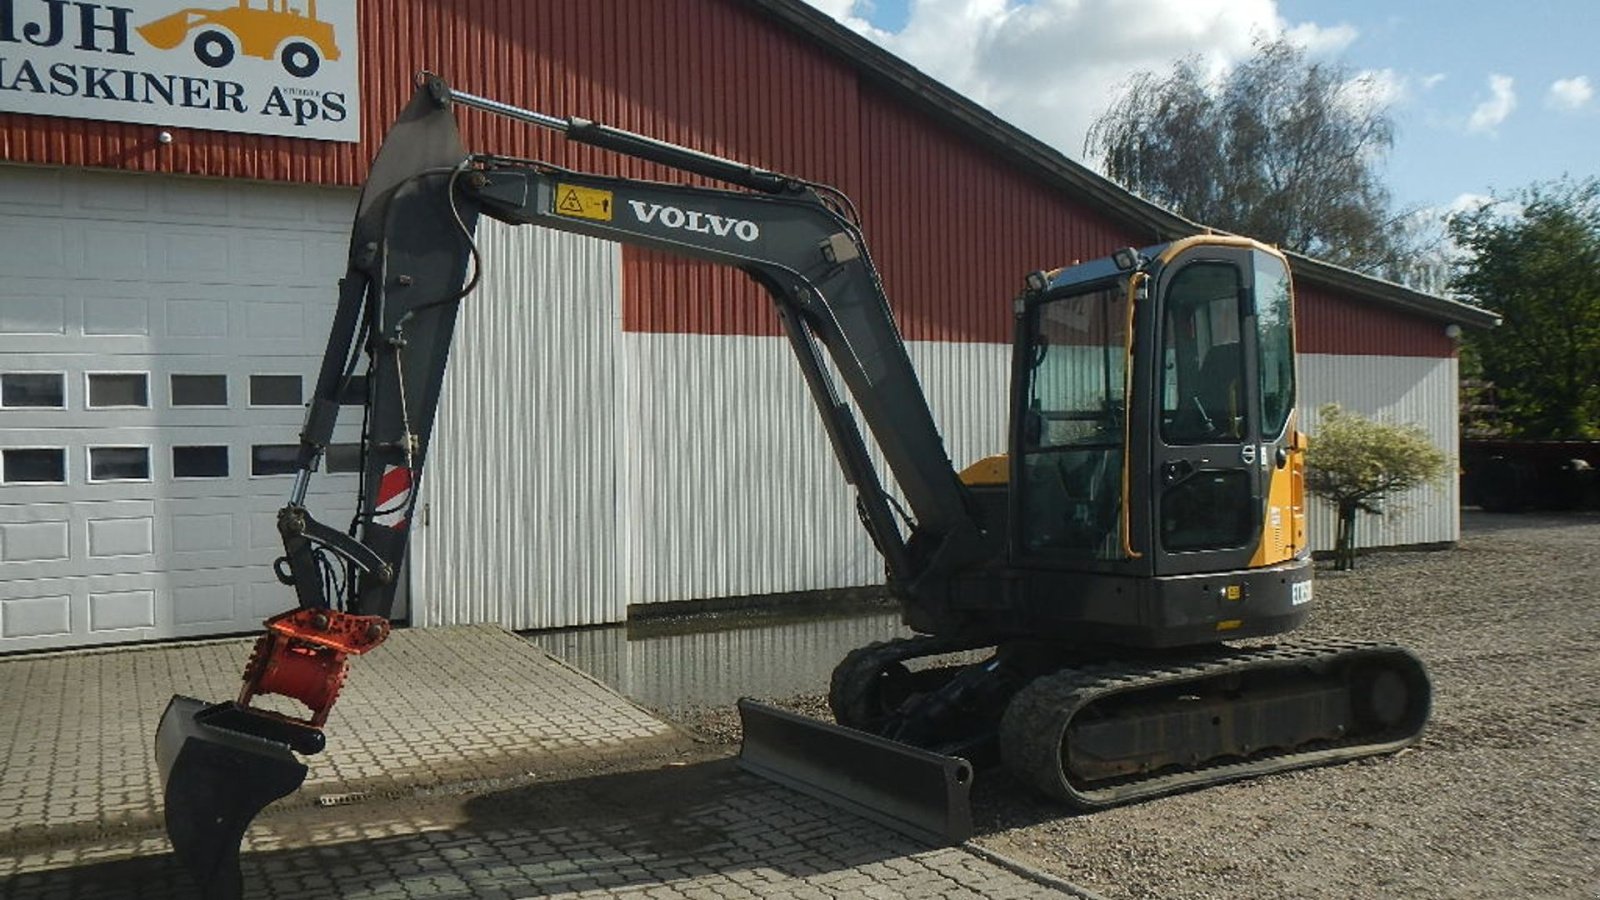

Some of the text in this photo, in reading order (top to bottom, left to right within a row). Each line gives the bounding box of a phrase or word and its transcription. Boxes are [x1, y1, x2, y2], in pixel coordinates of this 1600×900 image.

[0, 58, 346, 126] ASKINER ApS
[628, 200, 759, 242] VOLVO
